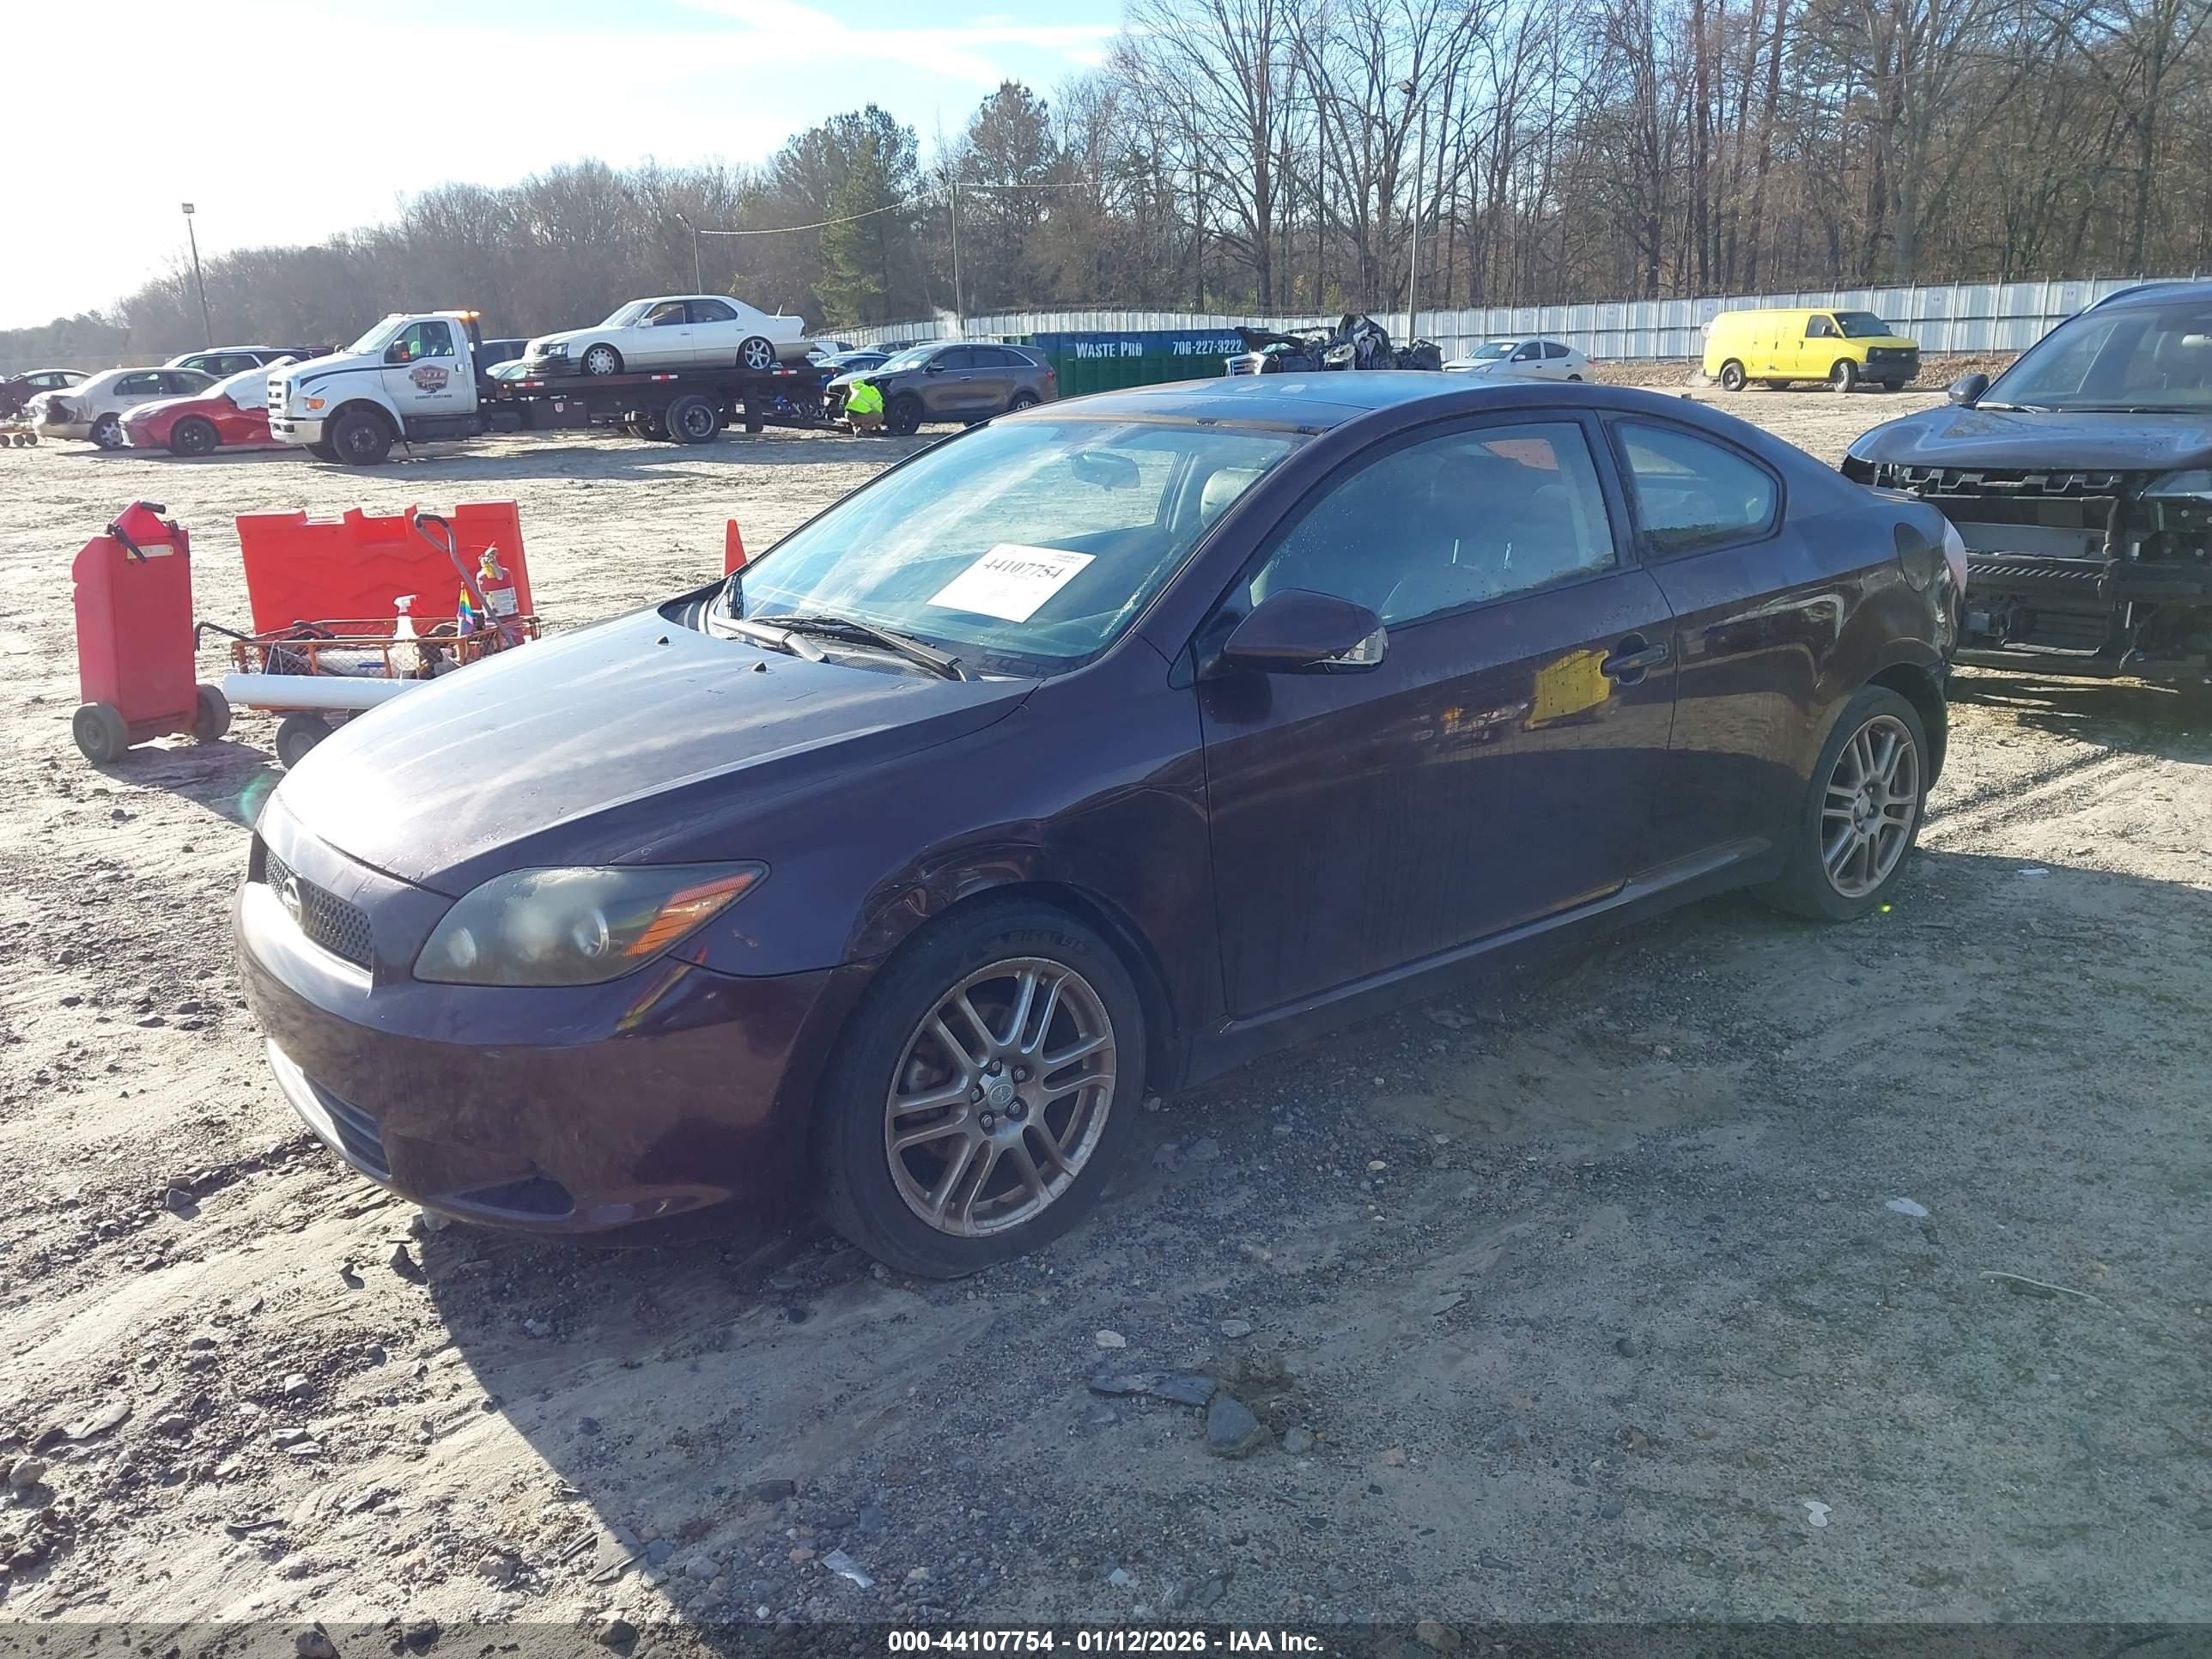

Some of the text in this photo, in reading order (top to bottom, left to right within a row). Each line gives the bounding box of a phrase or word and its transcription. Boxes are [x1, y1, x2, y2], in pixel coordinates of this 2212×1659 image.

[1075, 342, 1115, 358] WASTE
[1172, 338, 1243, 356] 706-227-3222
[983, 558, 1066, 580] 44107754
